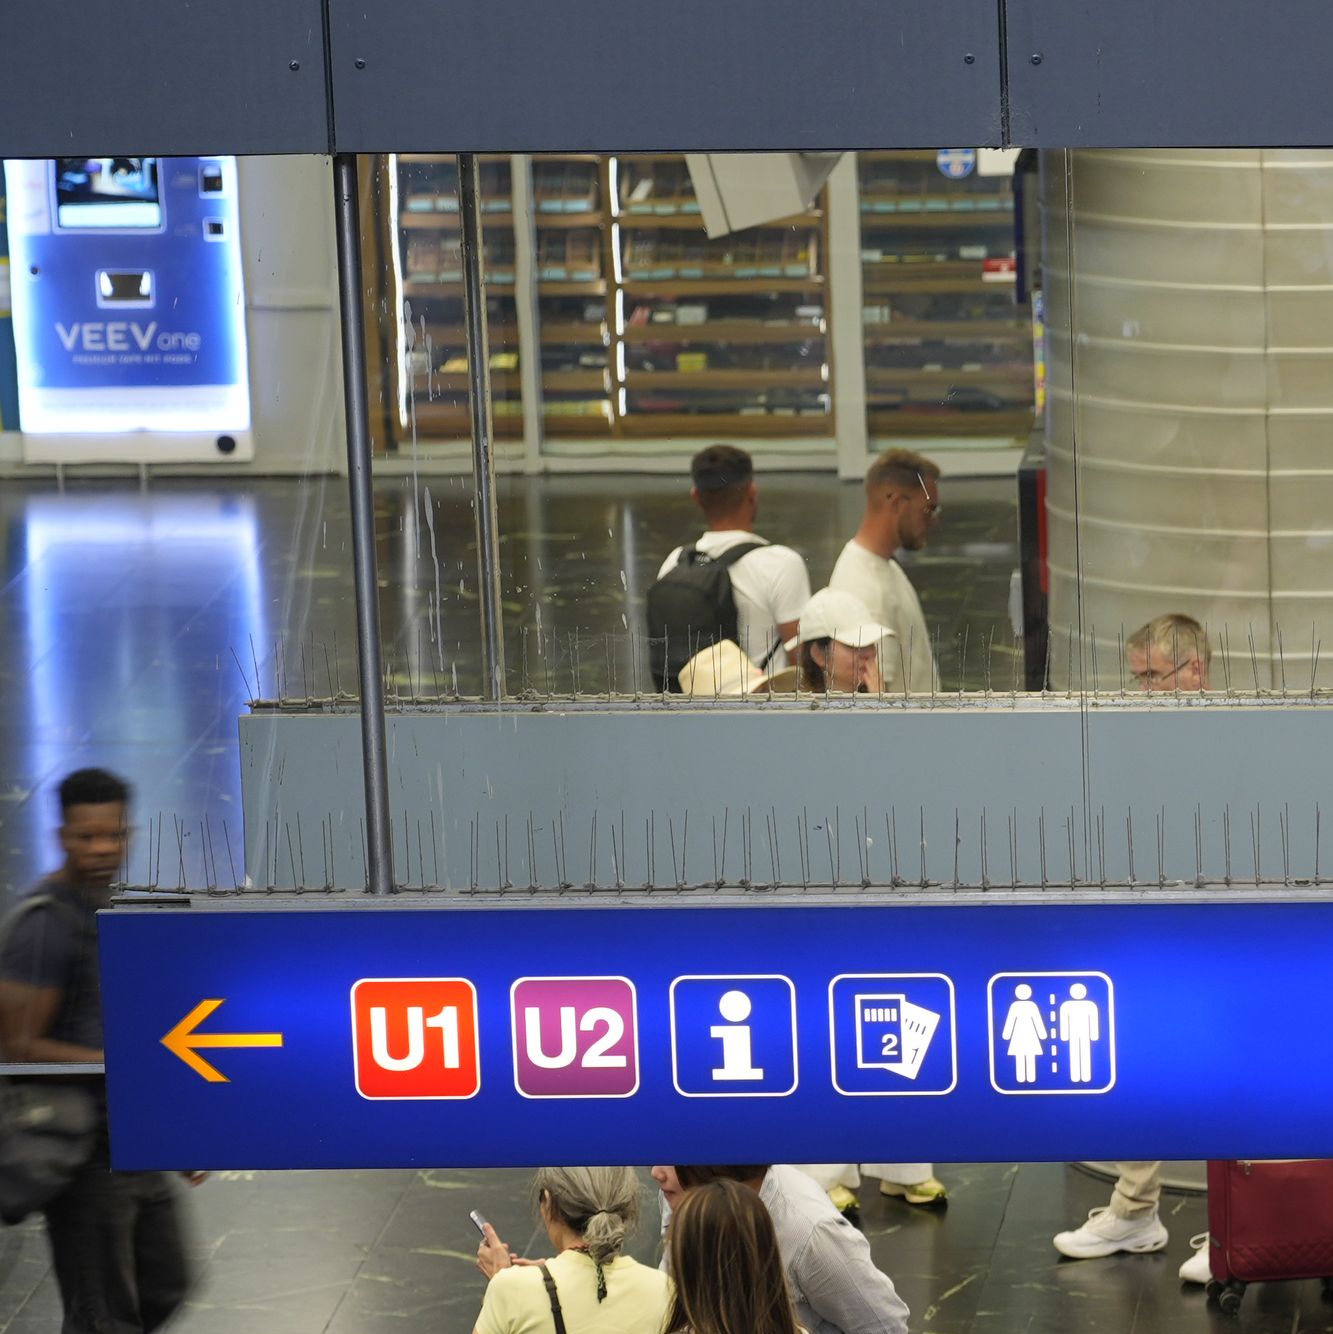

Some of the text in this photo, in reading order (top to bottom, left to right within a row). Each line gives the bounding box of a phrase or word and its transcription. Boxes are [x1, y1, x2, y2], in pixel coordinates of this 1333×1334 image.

[55, 322, 157, 350] VEEV
[371, 1006, 462, 1070] U1
[525, 1007, 627, 1069] U2
